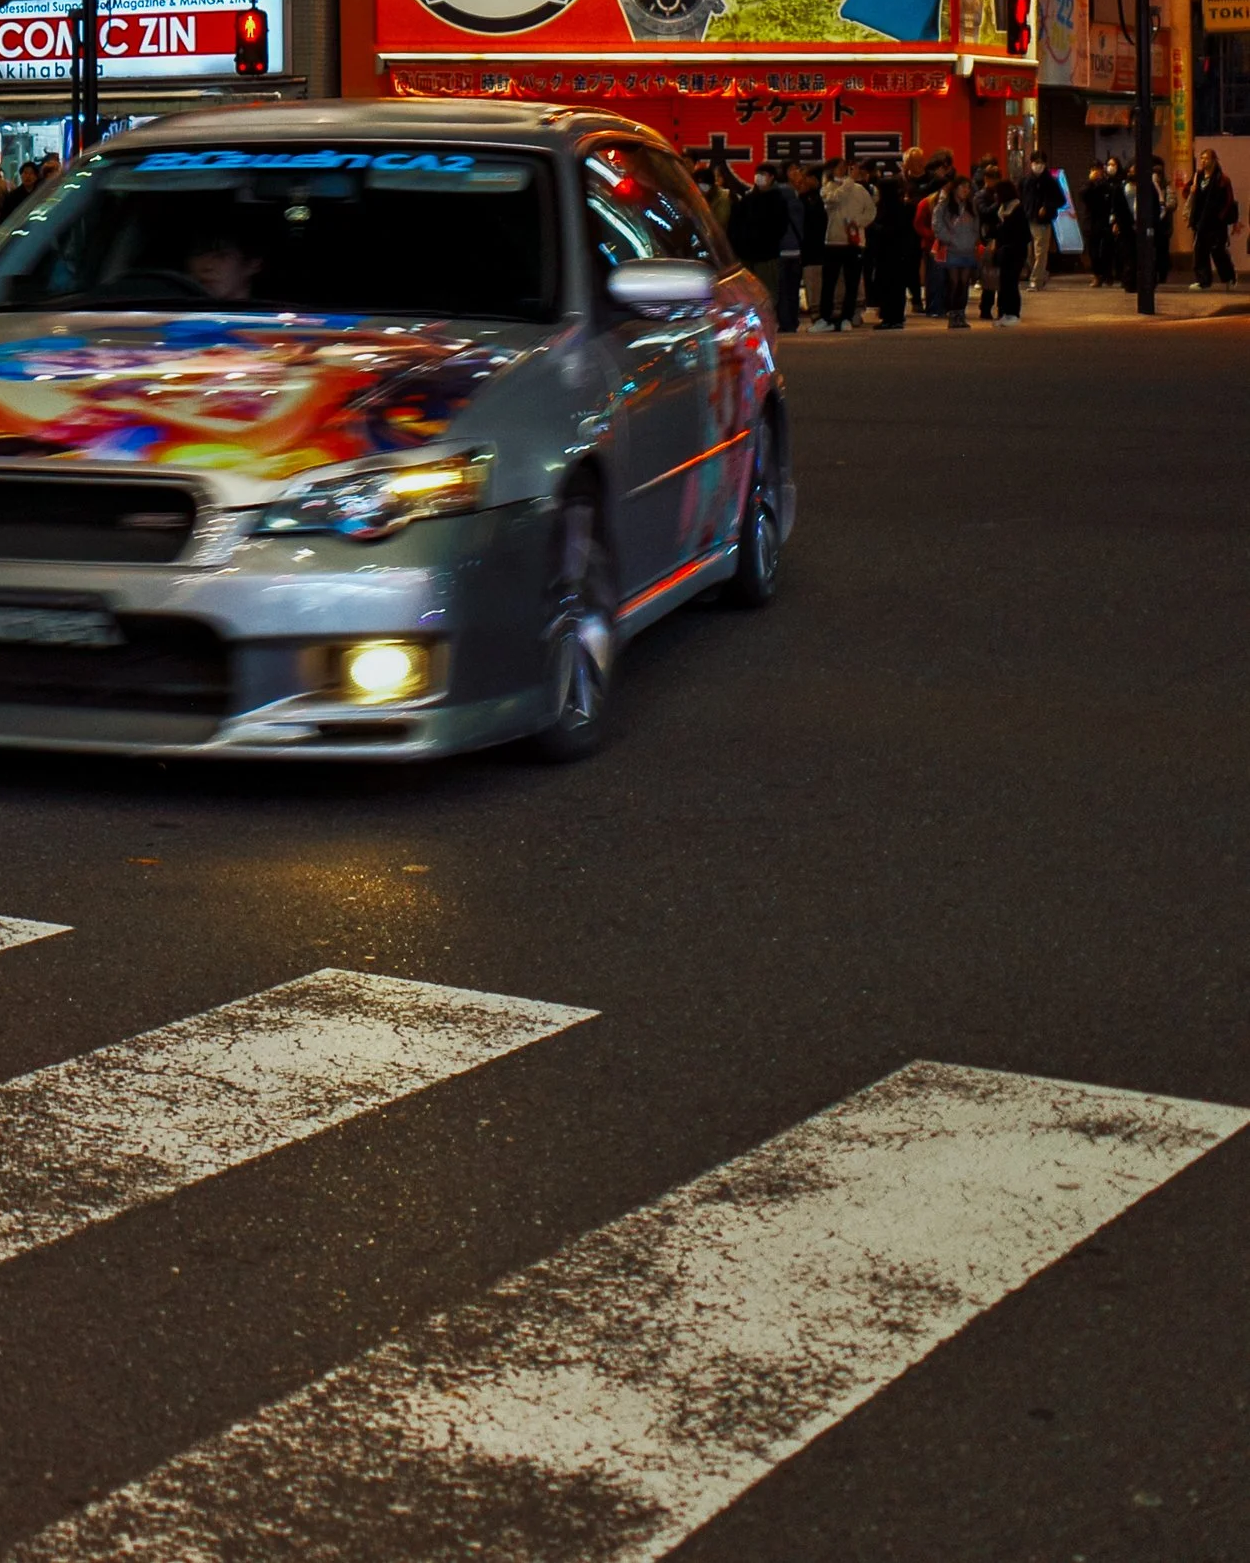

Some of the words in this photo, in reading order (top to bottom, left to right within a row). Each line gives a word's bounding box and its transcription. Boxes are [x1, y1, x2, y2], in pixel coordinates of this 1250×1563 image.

[138, 15, 197, 54] ZIN
[735, 98, 857, 124] チケット
